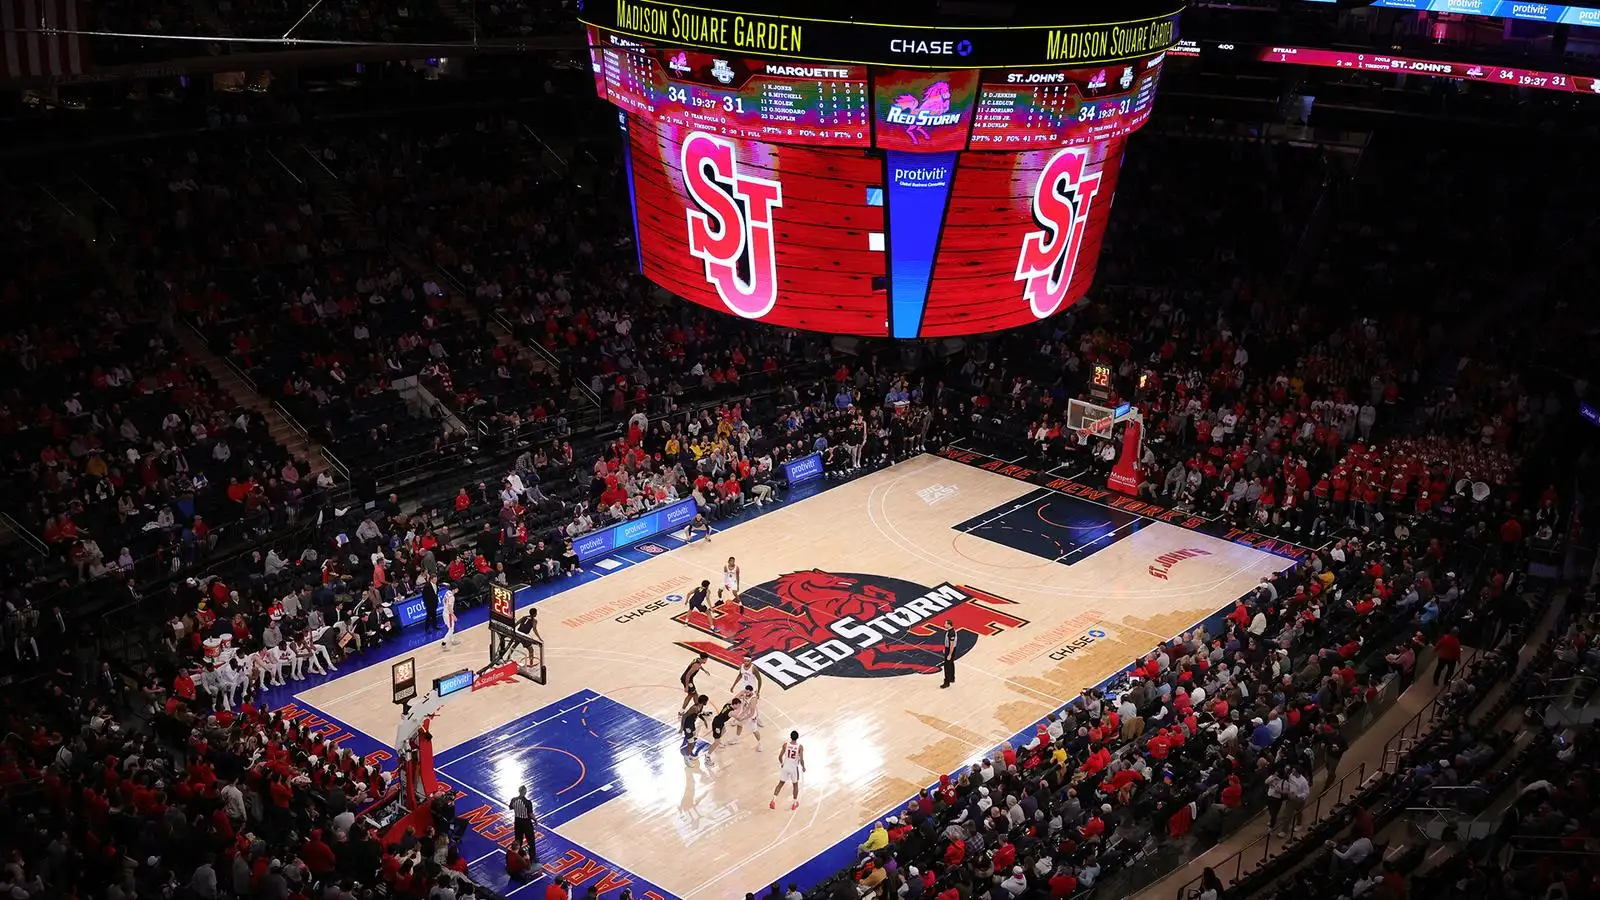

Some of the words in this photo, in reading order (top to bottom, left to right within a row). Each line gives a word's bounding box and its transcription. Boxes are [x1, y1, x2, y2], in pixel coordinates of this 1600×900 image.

[1512, 4, 1548, 14] protiviti
[617, 1, 668, 35] MADISON
[672, 9, 728, 45] SQUARE
[734, 16, 802, 52] GARDEN
[890, 39, 953, 55] CHASE
[1046, 30, 1108, 60] MADISON
[1110, 26, 1149, 56] SQUARE
[766, 65, 848, 78] MARQUETTE
[1391, 60, 1408, 69] ST.
[1408, 62, 1452, 73] JOHN'S
[1007, 74, 1024, 82] ST.
[1025, 74, 1064, 82] JOHN'S
[1500, 70, 1514, 80] 34
[1518, 76, 1548, 86] 19:37
[1552, 76, 1566, 86] 31
[668, 86, 687, 104] 34
[692, 97, 716, 108] 19:37
[723, 96, 744, 113] 31
[1118, 99, 1130, 115] 31
[1078, 106, 1096, 122] 34
[1098, 108, 1116, 119] 19:37
[895, 167, 946, 182] protiviti
[1094, 373, 1108, 386] 22
[792, 458, 816, 477] protiviti
[914, 483, 944, 498] BIG
[922, 484, 958, 504] EAST
[666, 506, 689, 522] protiviti
[980, 460, 1036, 480] ARE
[1047, 477, 1111, 500] NEW
[1110, 495, 1206, 530] YORK'S
[1224, 527, 1305, 558] TEAM
[624, 520, 648, 538] protiviti
[580, 536, 604, 554] protiviti
[495, 596, 509, 616] 22
[615, 600, 668, 624] CHASE
[754, 639, 855, 686] RED
[830, 585, 966, 648] STORM
[1049, 636, 1095, 661] CHASE
[442, 674, 469, 690] protiviti
[788, 750, 796, 759] 12
[543, 850, 633, 896] ARE
